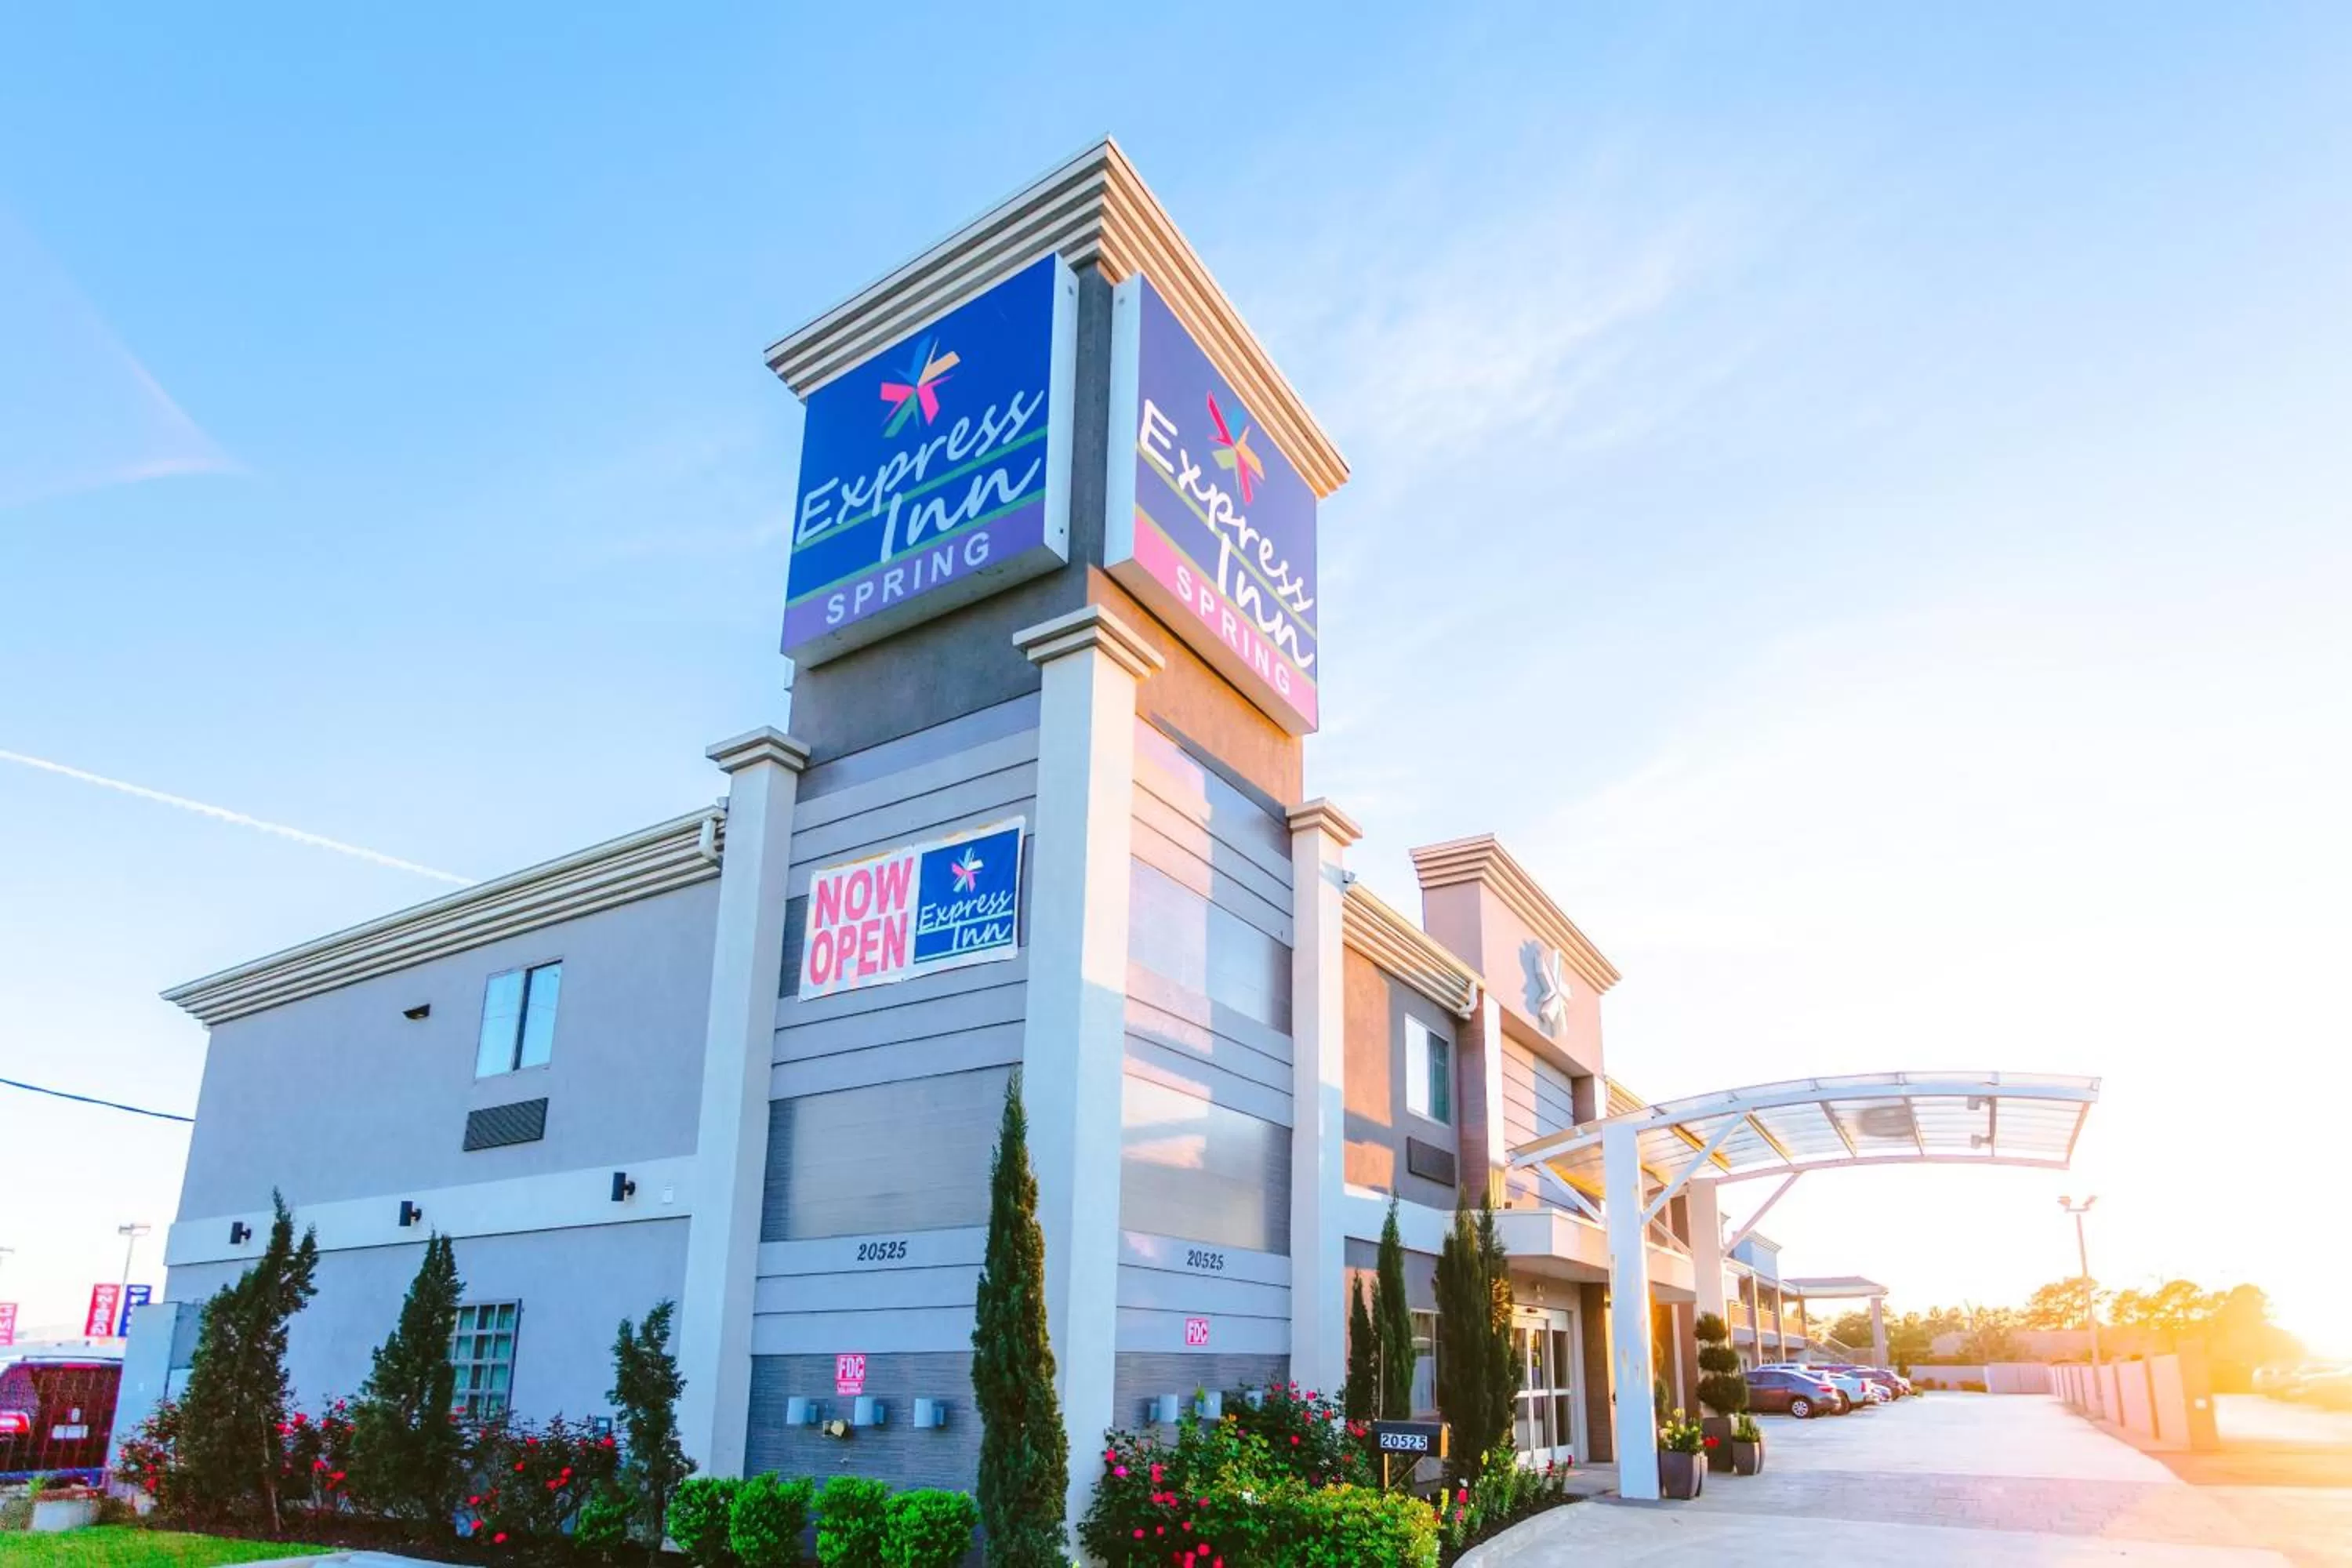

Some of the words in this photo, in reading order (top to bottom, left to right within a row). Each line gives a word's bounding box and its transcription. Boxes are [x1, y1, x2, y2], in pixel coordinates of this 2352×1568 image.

[796, 389, 1044, 544] Express
[880, 456, 1042, 563] Inn
[1140, 398, 1315, 612] Express
[826, 532, 990, 626] SPRING
[1217, 533, 1315, 670] Inn
[1176, 564, 1290, 695] SPRING
[815, 856, 914, 929] NOW
[919, 889, 1013, 931] Express
[810, 912, 908, 985] OPEN
[951, 921, 1011, 952] Inn
[857, 1240, 907, 1261] 20525
[1186, 1249, 1224, 1270] 20525
[838, 1357, 865, 1380] FDC
[1188, 1321, 1208, 1343] FDC
[1382, 1434, 1426, 1449] 20525
